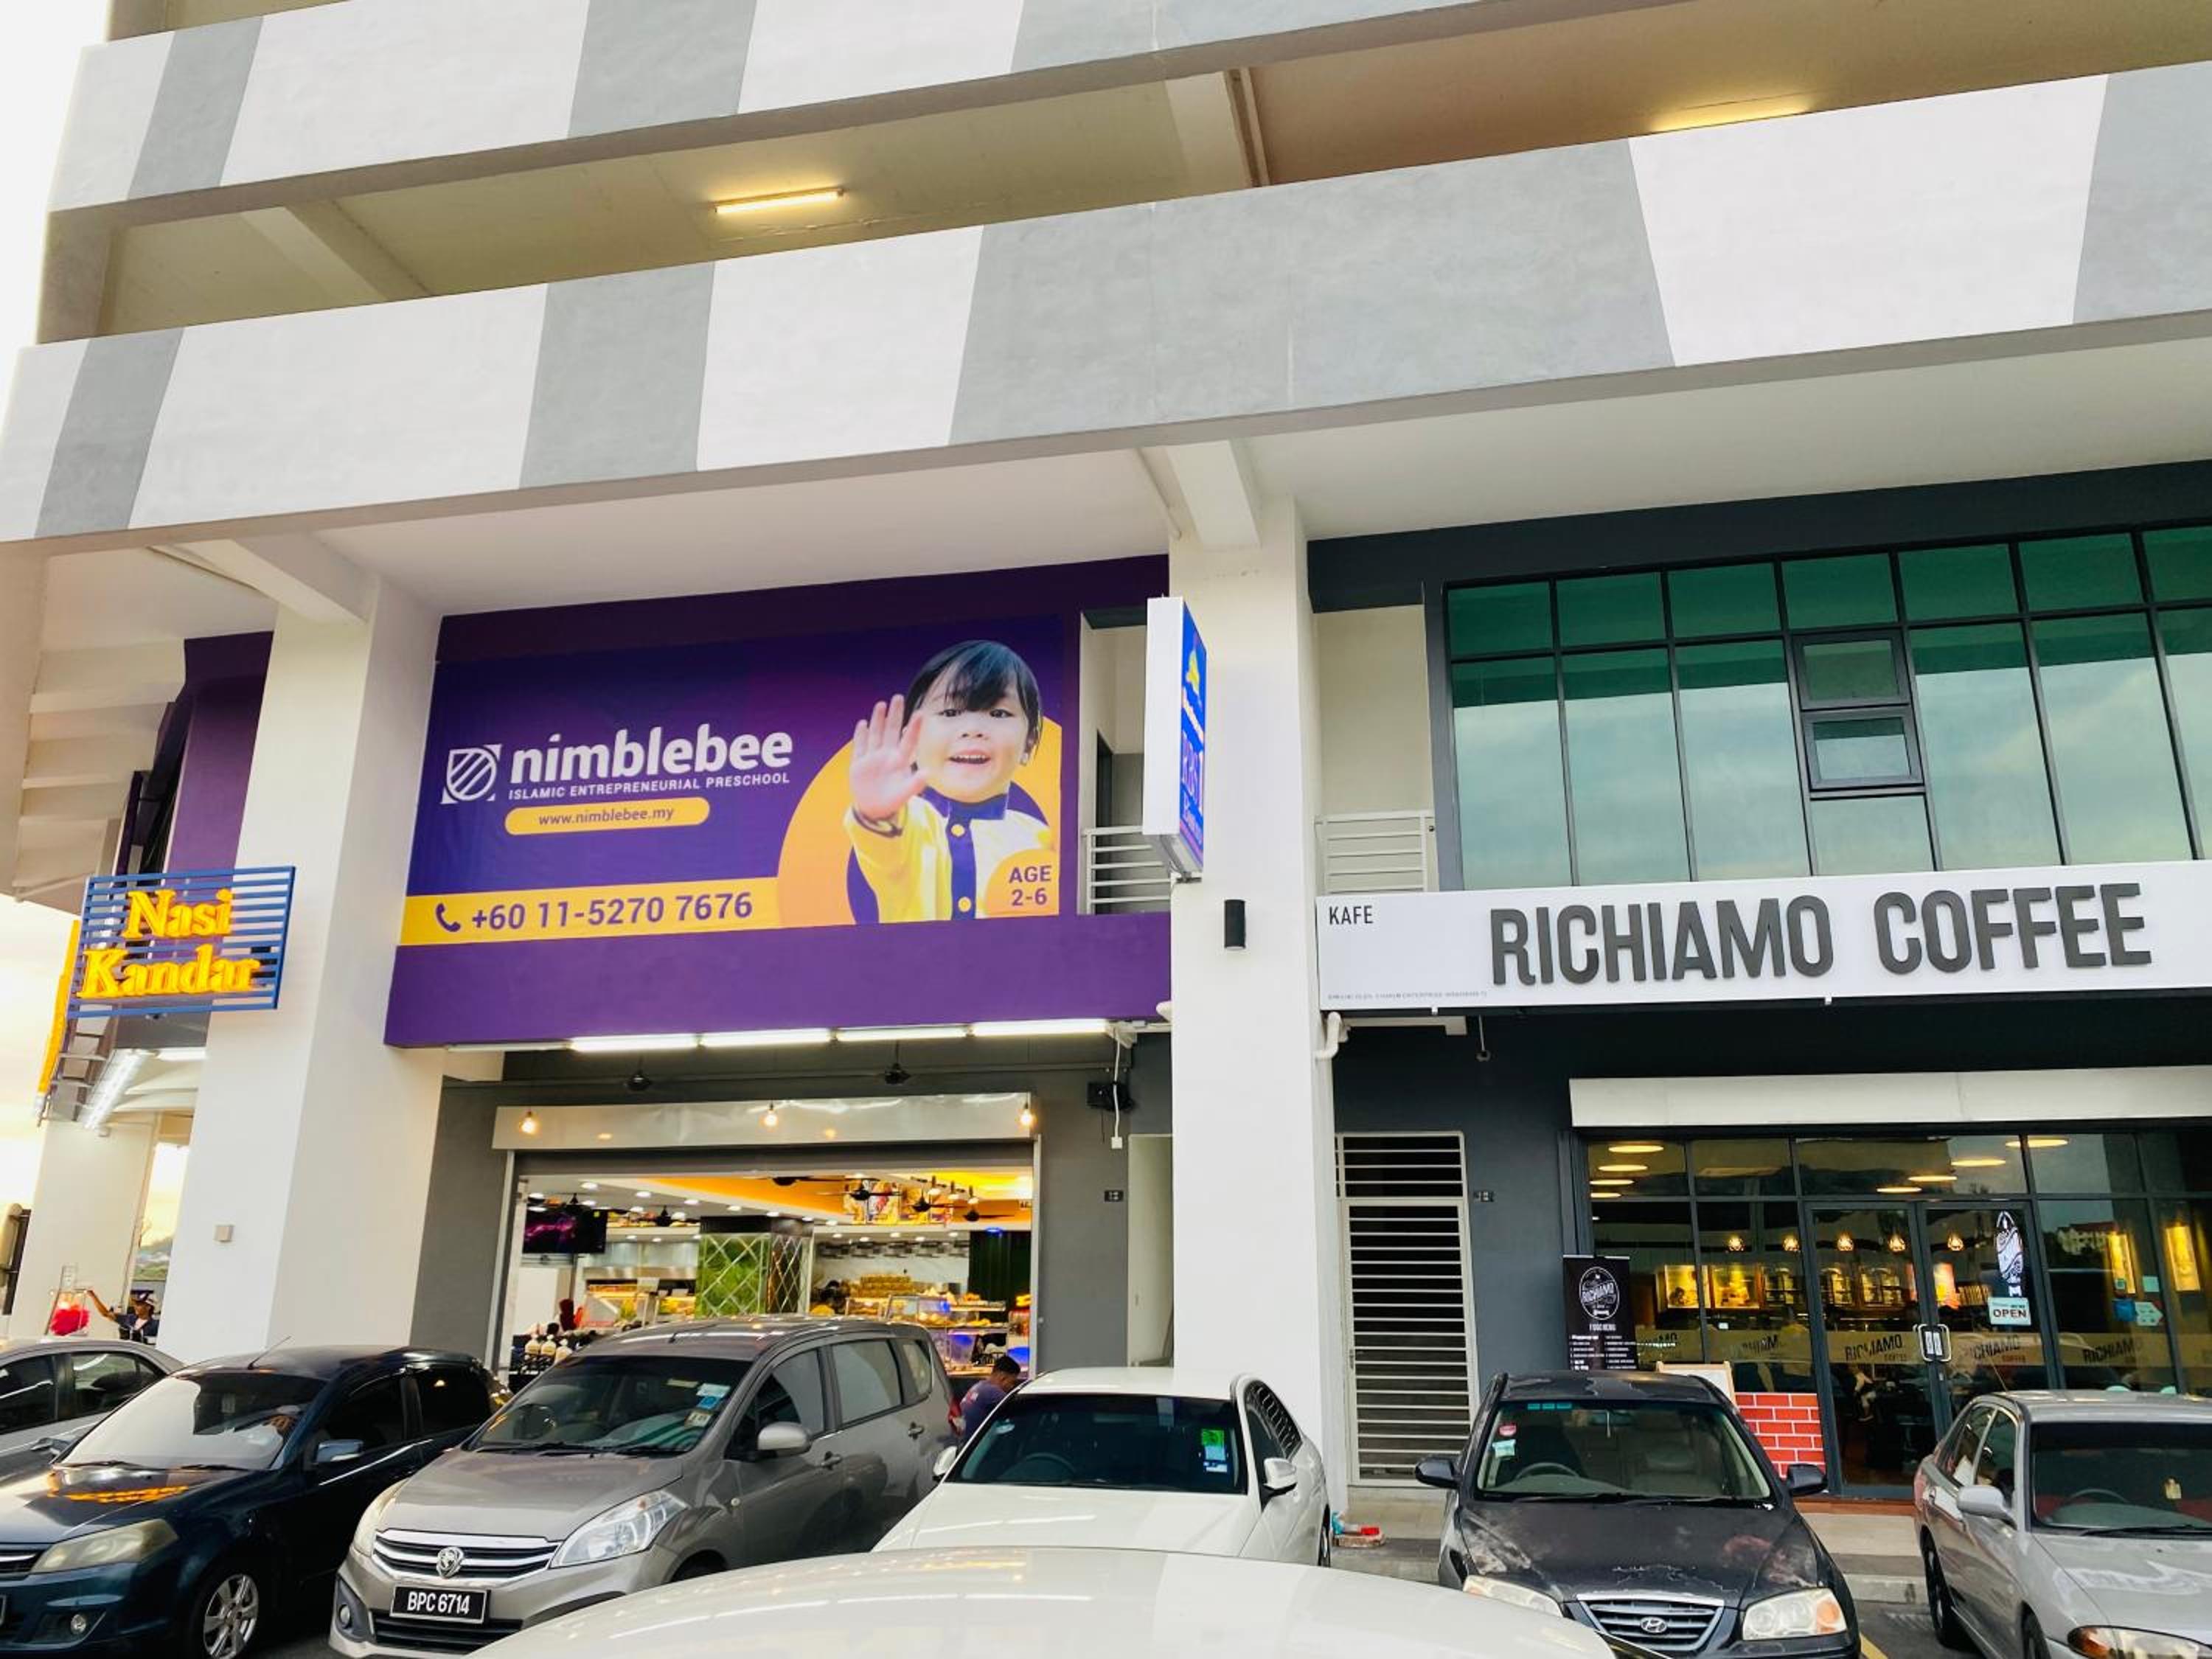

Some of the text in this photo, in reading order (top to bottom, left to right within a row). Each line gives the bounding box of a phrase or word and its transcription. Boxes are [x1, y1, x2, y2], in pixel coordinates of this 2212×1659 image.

[510, 724, 793, 784] nimblebee
[509, 772, 790, 800] ISLAMIC ENTREPRENEURIAL PRESCHOOL
[538, 807, 675, 826] www.nimblebee.my
[1009, 865, 1052, 883] AGE
[472, 891, 754, 930] +60 11-5270 7676
[1011, 888, 1048, 907] 2-6
[121, 888, 234, 939] Nasi
[1328, 905, 1374, 925] KAFE
[1490, 883, 2152, 987] RICHIAMO COFFEE
[76, 943, 261, 998] Kandar
[1993, 1309, 2027, 1318] OPEN
[407, 1591, 470, 1615] BPC 6714
